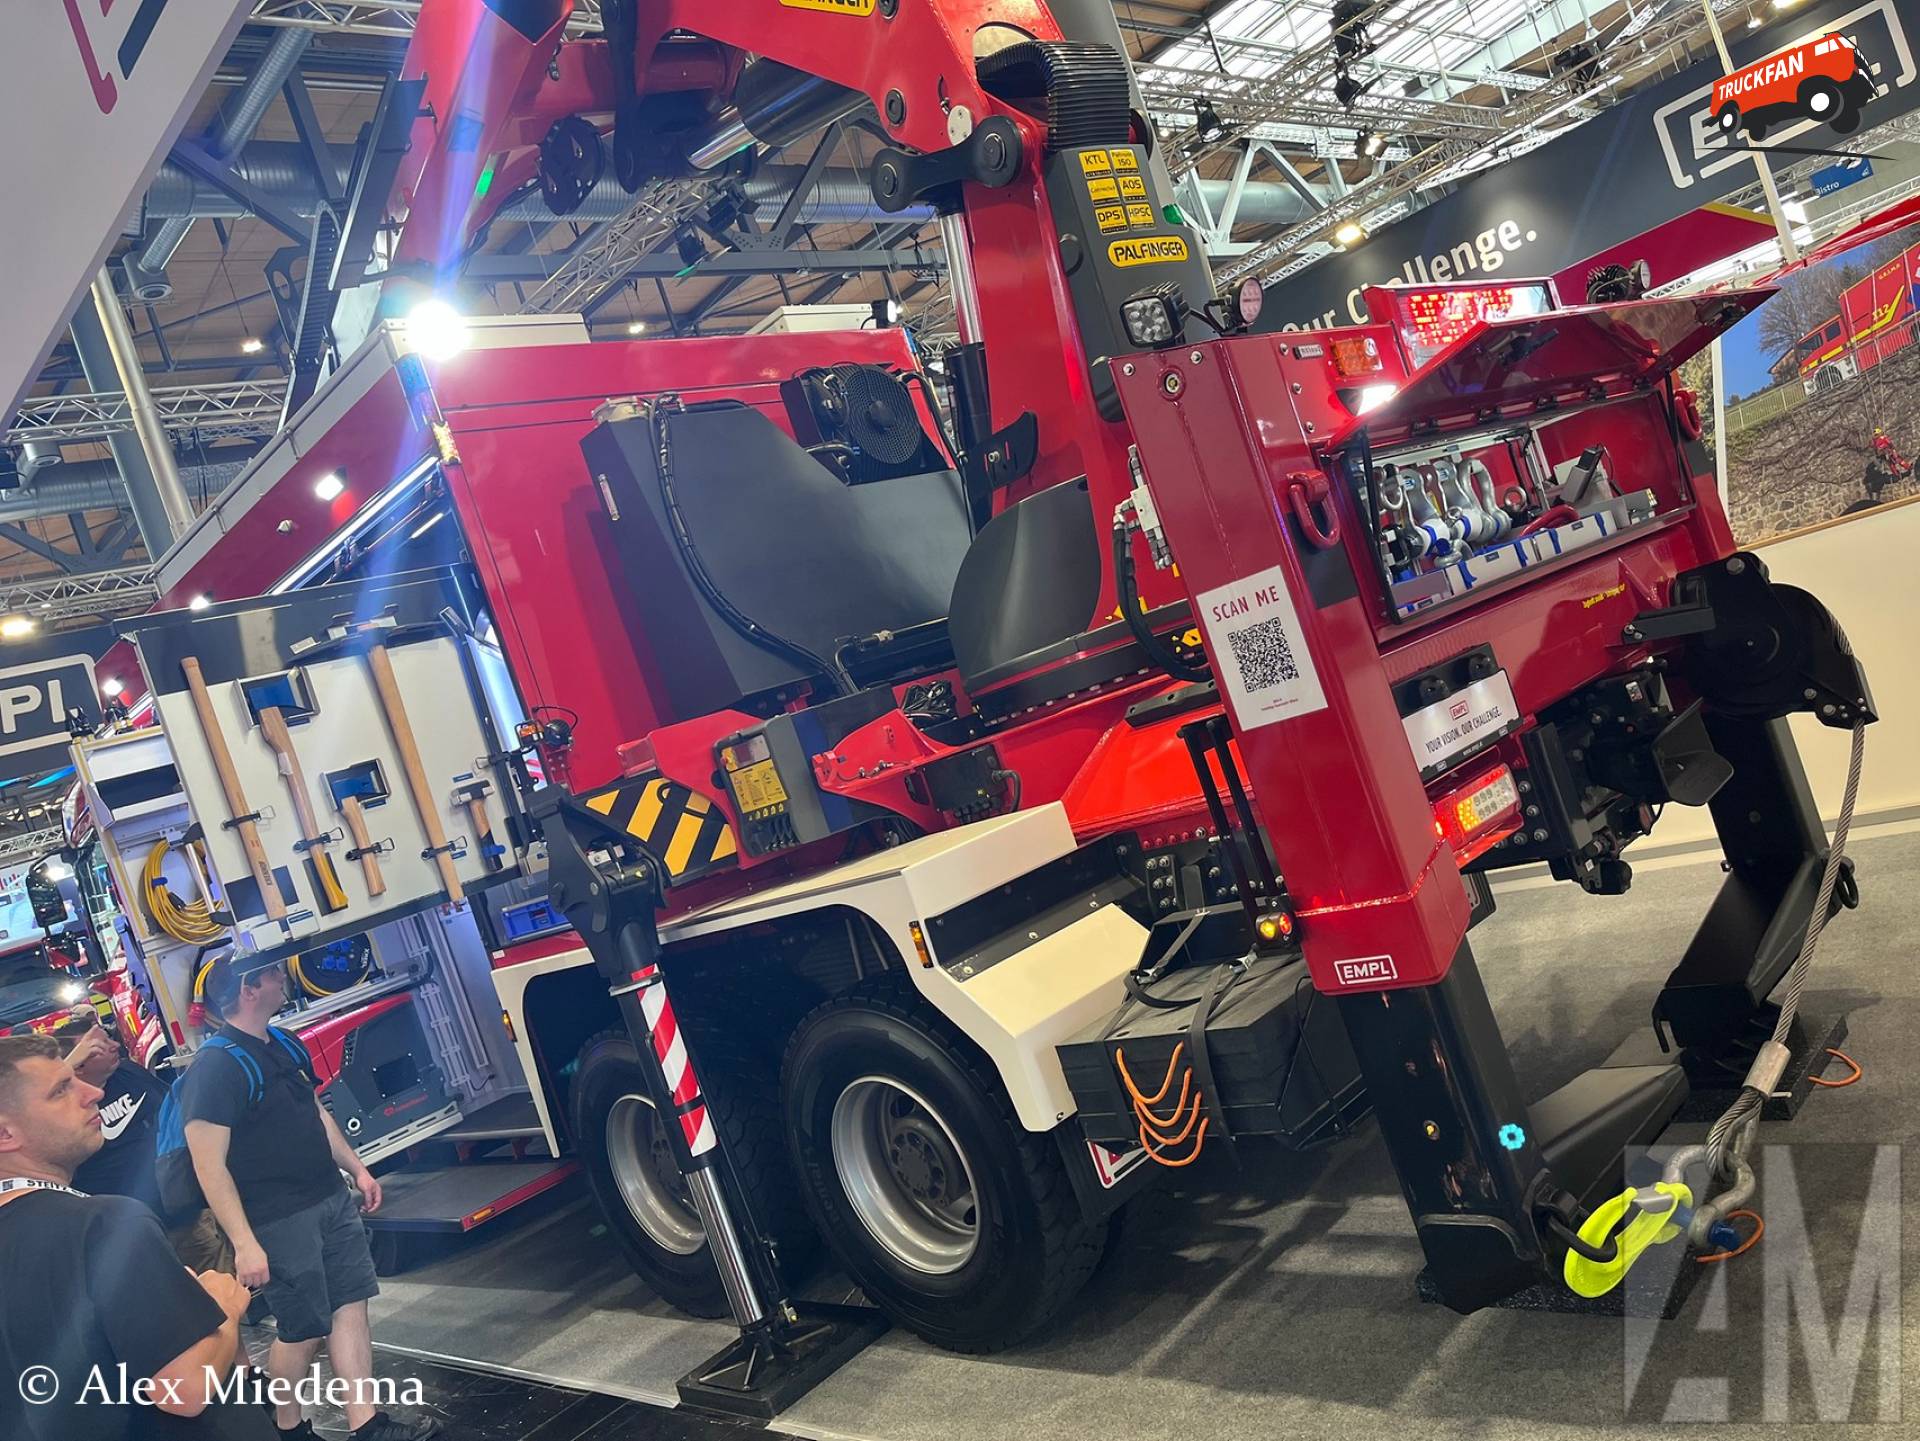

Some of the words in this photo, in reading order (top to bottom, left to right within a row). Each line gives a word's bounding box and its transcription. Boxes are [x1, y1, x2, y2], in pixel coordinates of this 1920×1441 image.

[1085, 154, 1105, 165] KTL
[1122, 180, 1142, 190] AOS
[1129, 207, 1151, 217] HPSC
[1113, 241, 1185, 262] PALFINGER
[1346, 219, 1538, 325] Cllenge.
[1871, 303, 1890, 321] 112
[1212, 595, 1249, 622] SCAN
[1255, 585, 1280, 607] ME
[1425, 736, 1443, 754] YOUR
[1441, 727, 1462, 746] VISION.
[1461, 720, 1474, 735] OUR
[1472, 705, 1502, 729] CHALLENGE.
[1343, 961, 1390, 979] EMPL
[99, 1093, 136, 1126] NIKE
